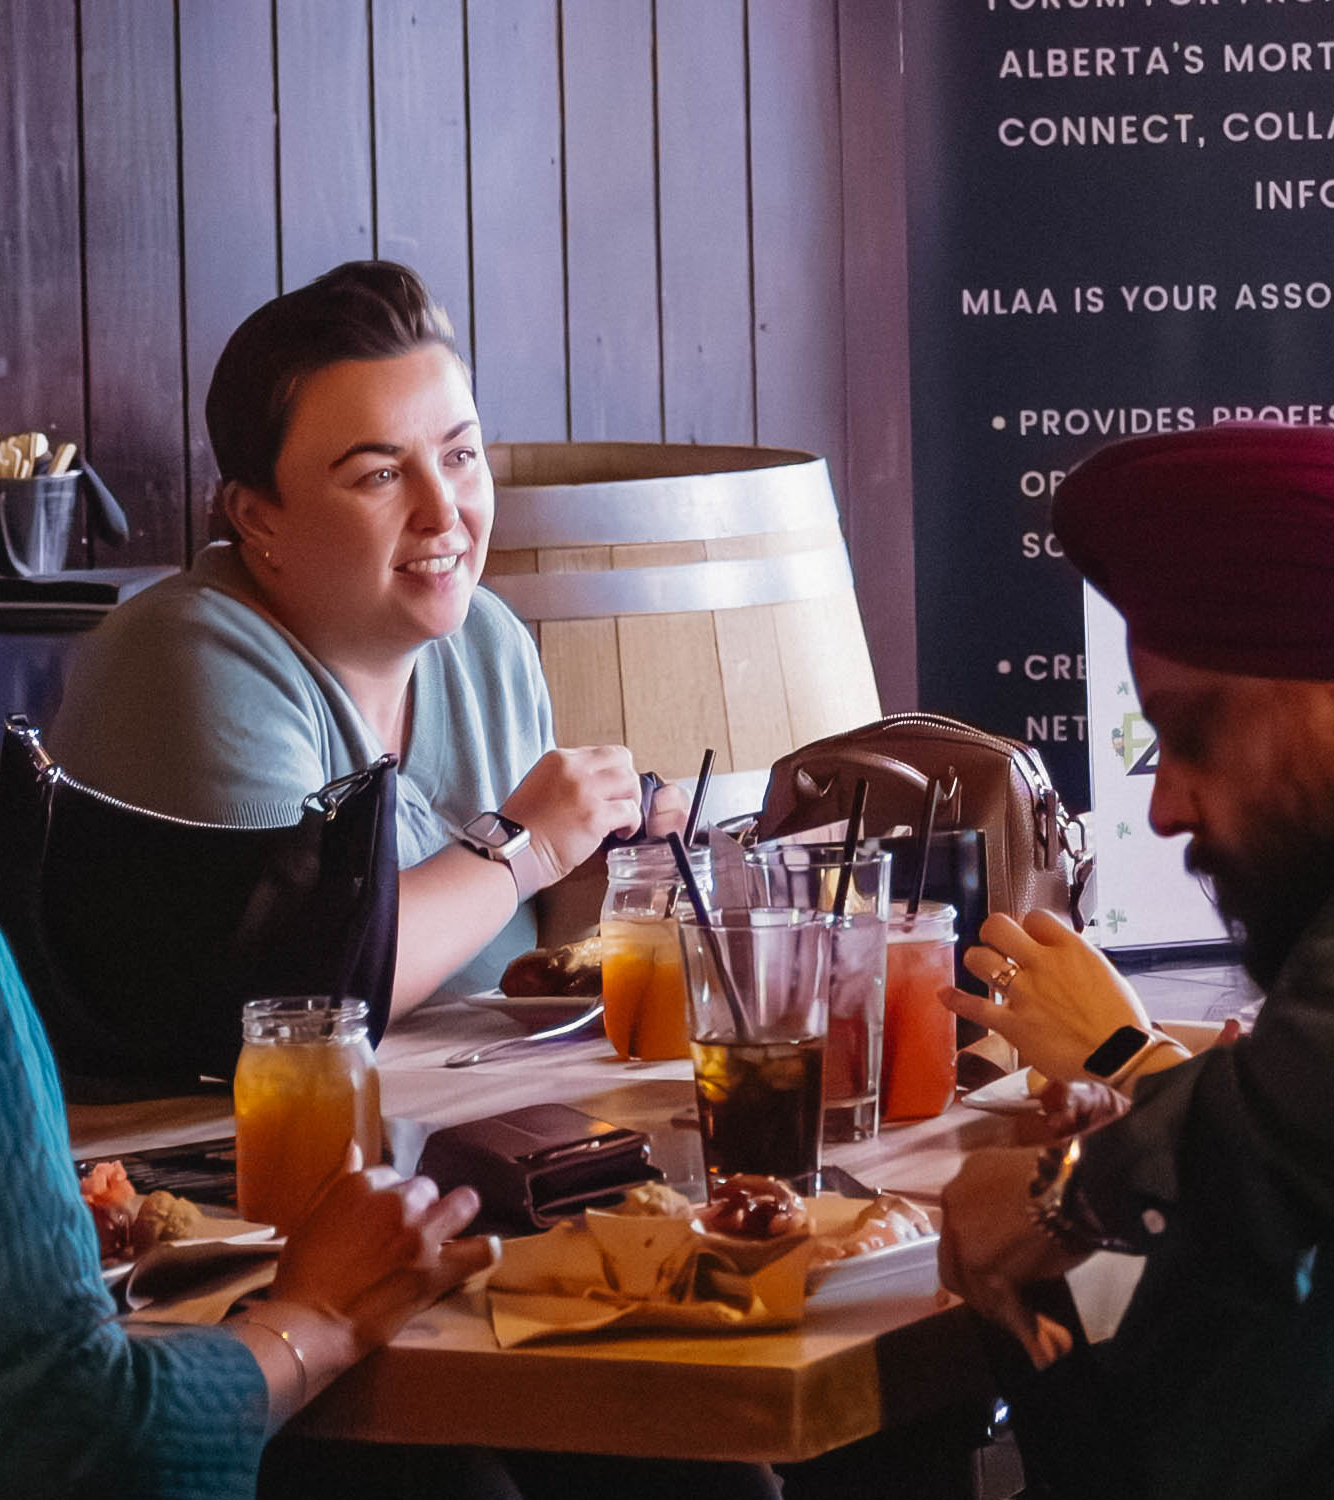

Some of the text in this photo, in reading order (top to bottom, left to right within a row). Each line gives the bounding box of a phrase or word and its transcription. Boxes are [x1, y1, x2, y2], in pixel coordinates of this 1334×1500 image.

[999, 42, 1204, 78] ALBERTA'S
[998, 114, 1205, 148] CONNECT,
[962, 288, 1057, 315] MLAA
[1074, 286, 1104, 313] IS
[1121, 284, 1217, 312] YOUR
[1020, 406, 1196, 436] PROVIDES
